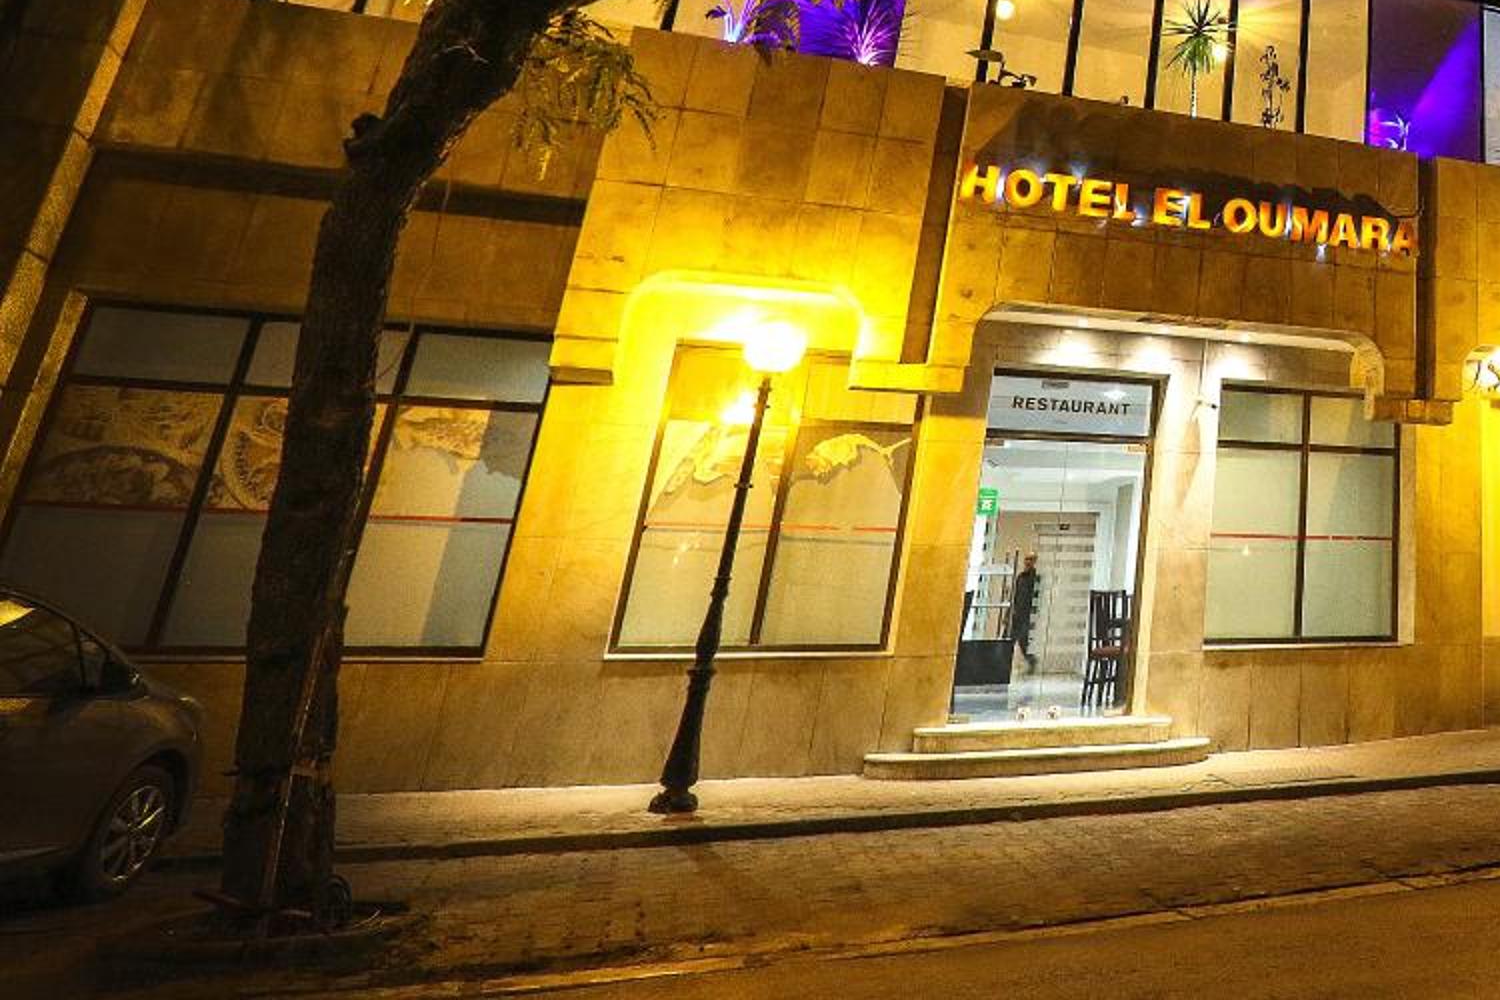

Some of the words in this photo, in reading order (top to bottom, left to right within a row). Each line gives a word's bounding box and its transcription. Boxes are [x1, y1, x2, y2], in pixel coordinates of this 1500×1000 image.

[959, 164, 1136, 221] HOTEL
[1153, 187, 1211, 230] EL
[1222, 197, 1419, 256] OUMARA
[1012, 395, 1131, 415] RESTAURANT
